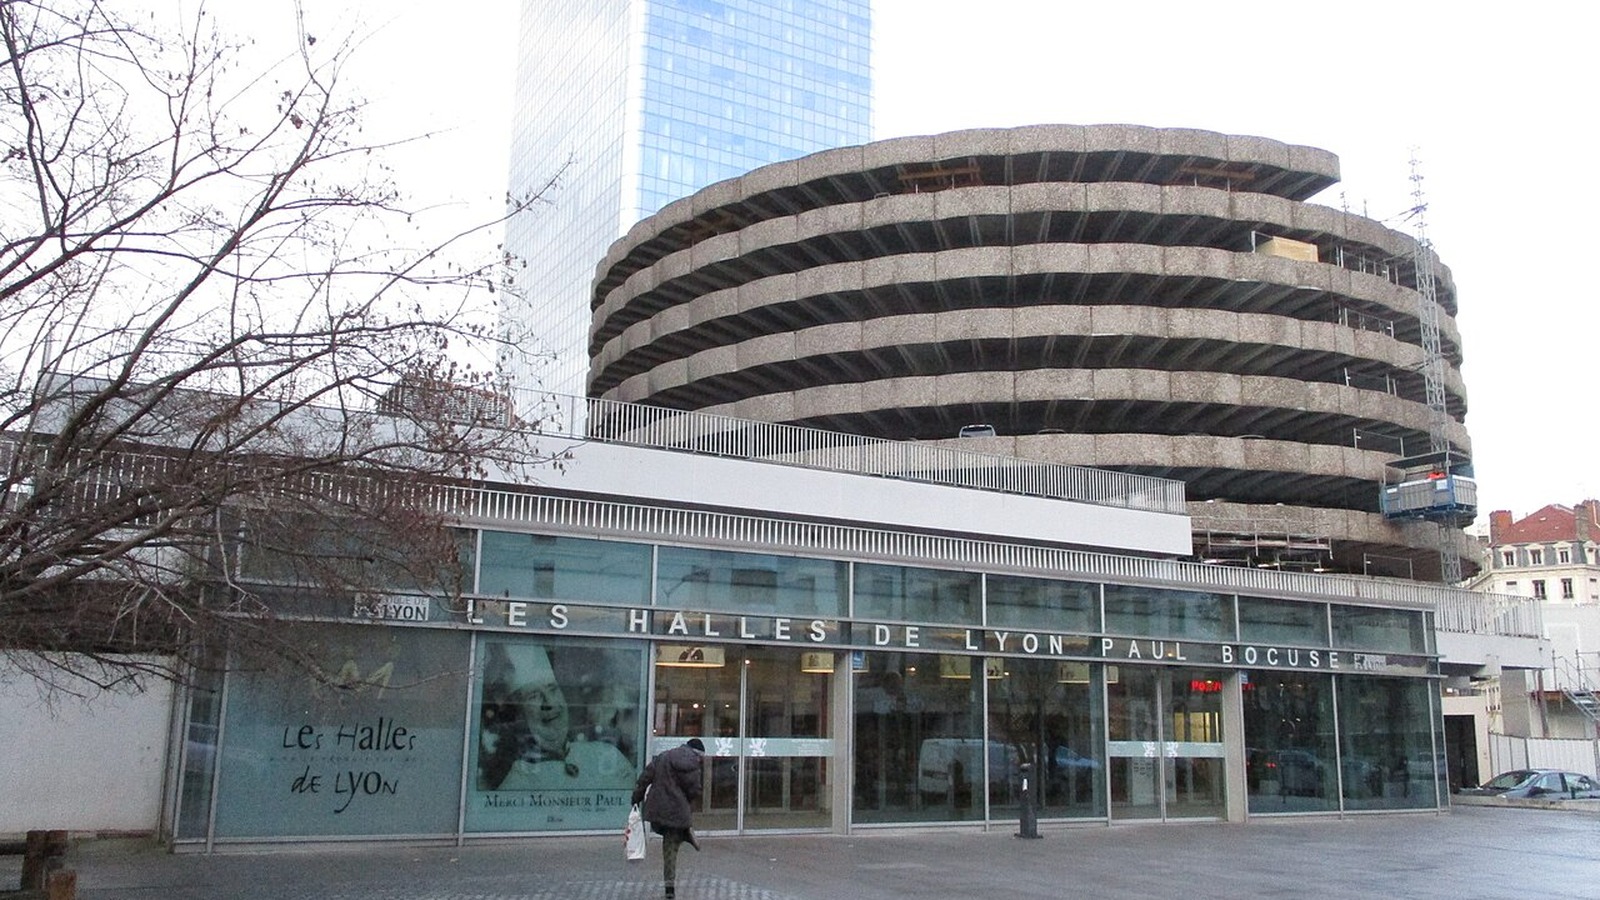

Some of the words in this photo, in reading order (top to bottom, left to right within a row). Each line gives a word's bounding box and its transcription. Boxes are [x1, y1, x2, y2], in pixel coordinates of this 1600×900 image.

[383, 604, 427, 620] LYON
[467, 600, 568, 628] LES
[629, 609, 826, 642] HALLES
[875, 624, 919, 647] DE
[965, 630, 1063, 655] LYON
[1102, 638, 1186, 661] PAUL
[1222, 645, 1340, 669] BOCUSE
